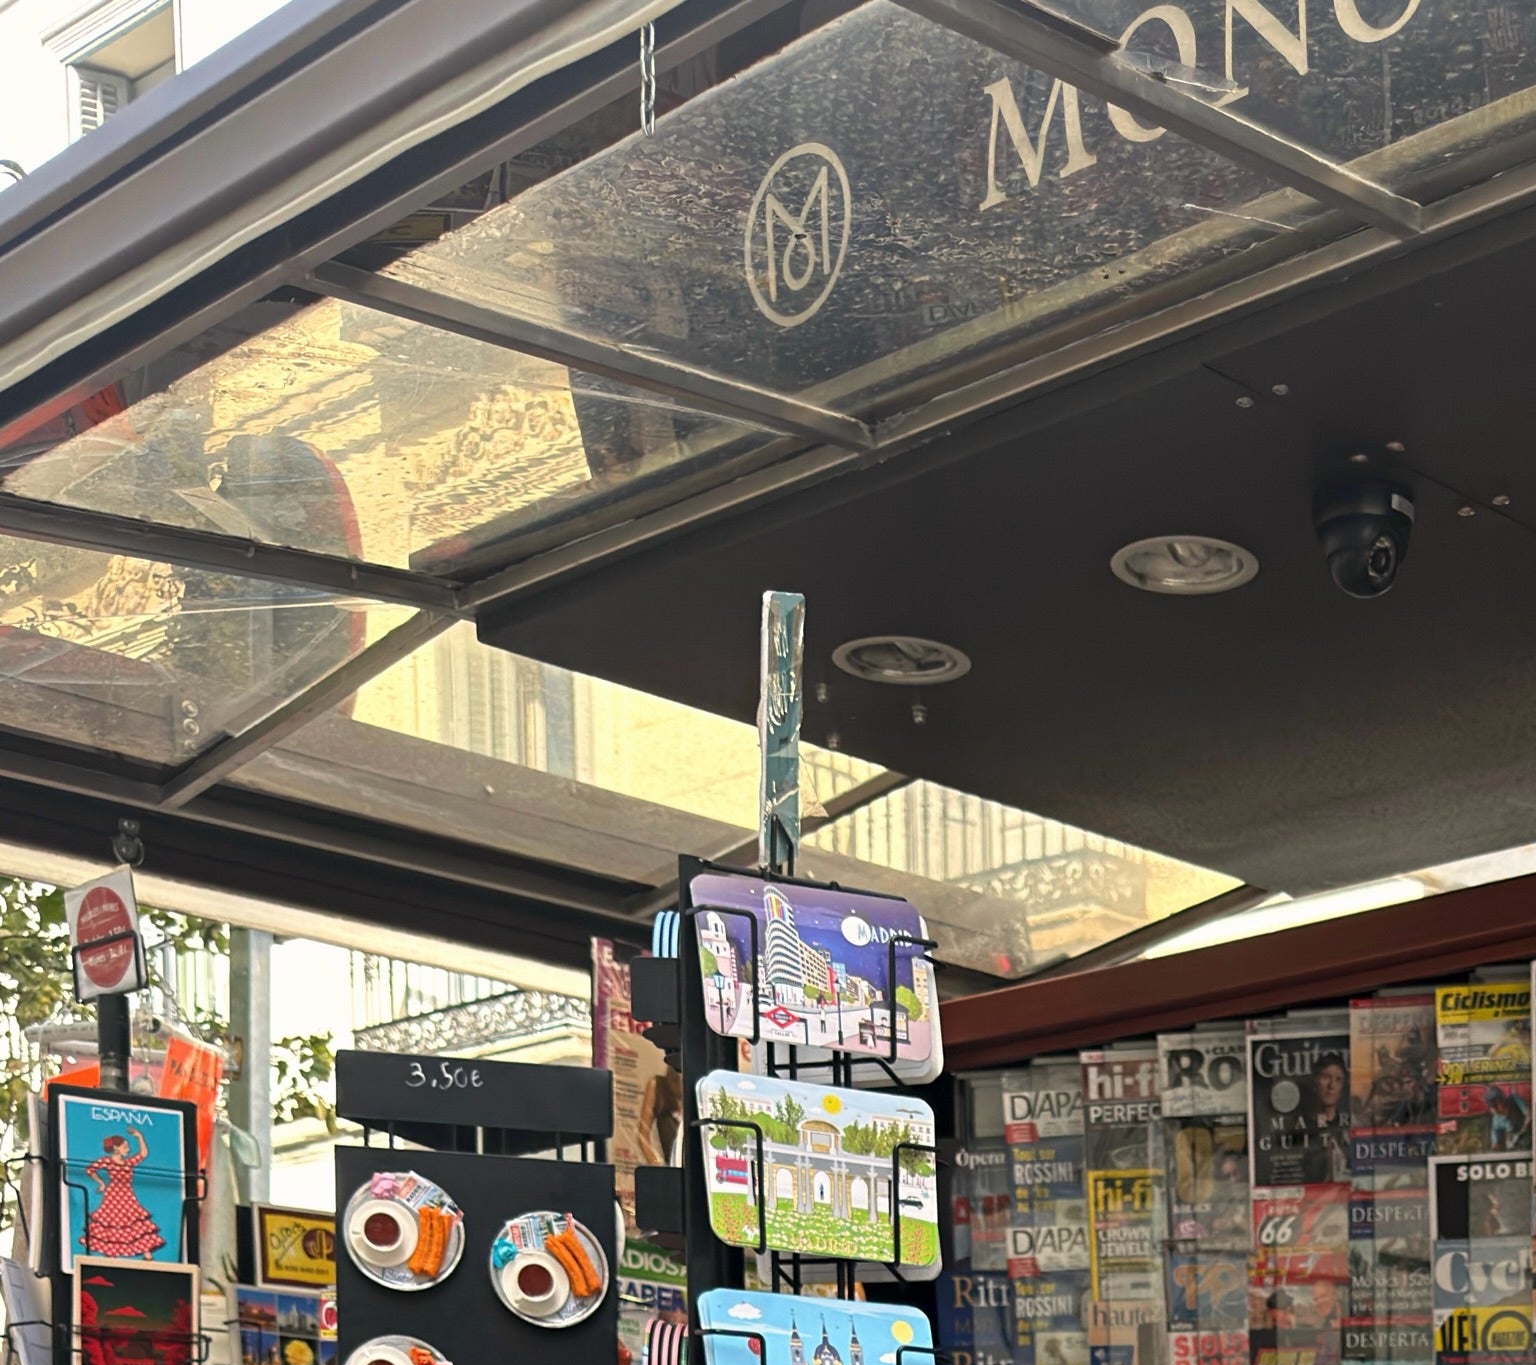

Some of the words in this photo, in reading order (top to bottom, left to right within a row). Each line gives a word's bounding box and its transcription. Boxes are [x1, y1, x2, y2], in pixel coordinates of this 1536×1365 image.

[91, 1107, 153, 1125] ESPAÑA
[1457, 1164, 1509, 1181] SOLO
[1261, 1216, 1294, 1244] 66
[1345, 1330, 1428, 1351] DESPERTA
